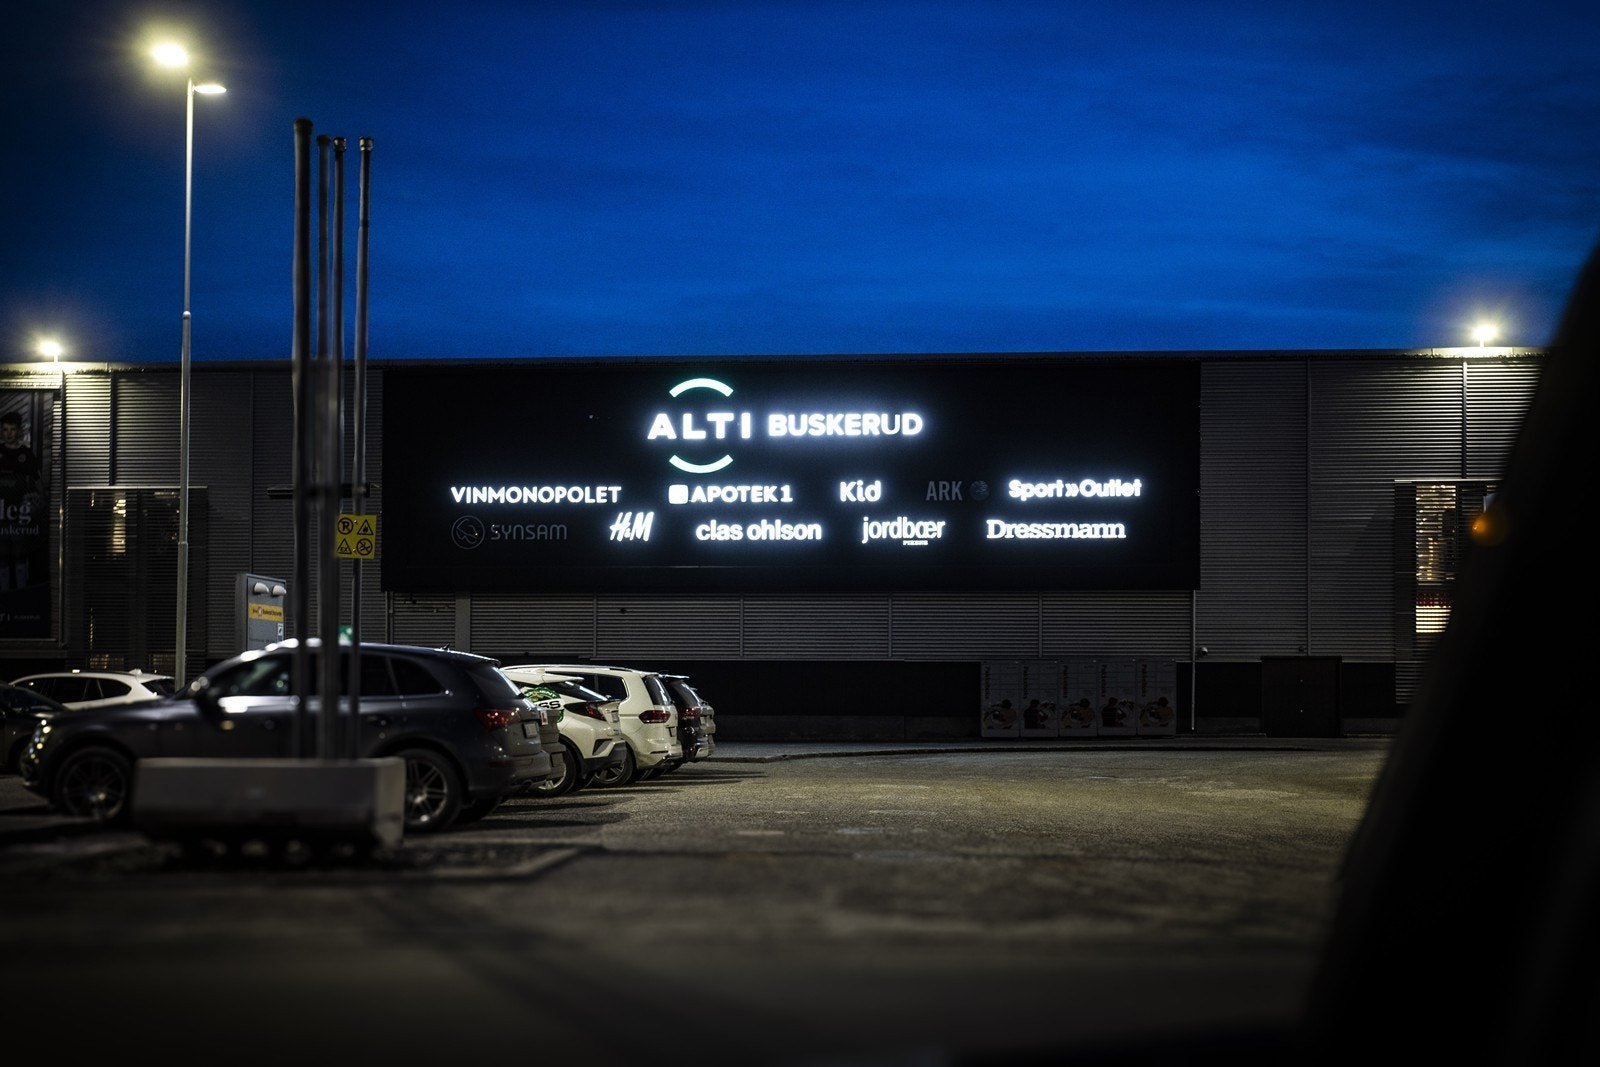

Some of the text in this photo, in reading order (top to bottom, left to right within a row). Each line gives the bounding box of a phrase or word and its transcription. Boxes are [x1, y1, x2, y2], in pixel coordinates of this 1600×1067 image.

[647, 411, 924, 440] ALTI BUSKERUD
[450, 485, 622, 504] VINMONOPOLET
[839, 479, 882, 503] Kid
[925, 480, 963, 502] ARK
[490, 523, 568, 541] SYNSAM
[609, 511, 655, 542] H&M
[695, 519, 823, 541] clas ohlson
[985, 519, 1127, 539] Dressmann
